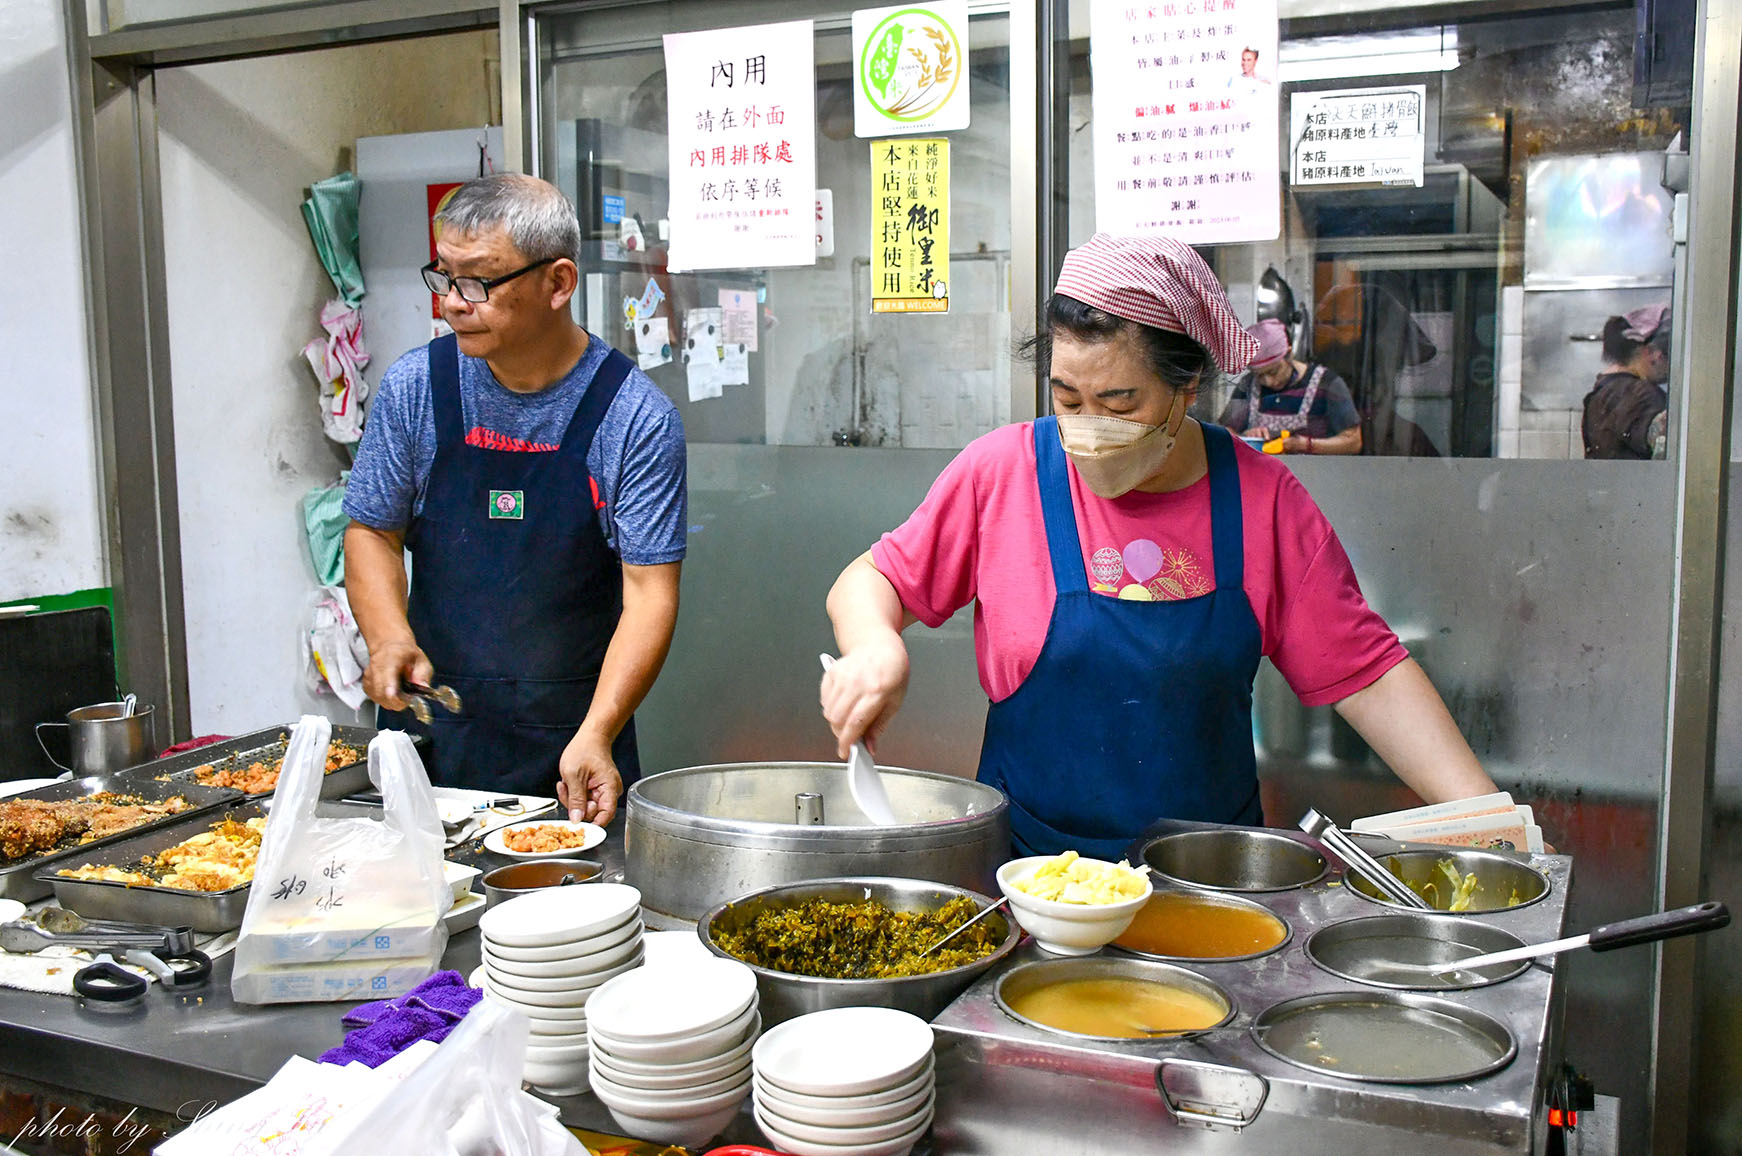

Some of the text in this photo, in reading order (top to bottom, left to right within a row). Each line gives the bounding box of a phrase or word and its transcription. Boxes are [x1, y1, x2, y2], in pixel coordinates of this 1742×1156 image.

[710, 54, 766, 89] 內用
[695, 104, 785, 133] 請在外面
[1306, 112, 1328, 125] 本店
[1302, 126, 1366, 142] 豬原料產地
[690, 139, 794, 168] 內用排隊處
[1302, 150, 1327, 163] 本店
[907, 144, 919, 199] 來自花蓮
[926, 143, 938, 198] 純淨好米
[1302, 164, 1365, 180] 豬原料產地
[701, 177, 782, 202] 依序等候
[882, 144, 902, 293] 本店堅持使用
[906, 203, 939, 293] 御皇米
[907, 300, 946, 310] WELCOME
